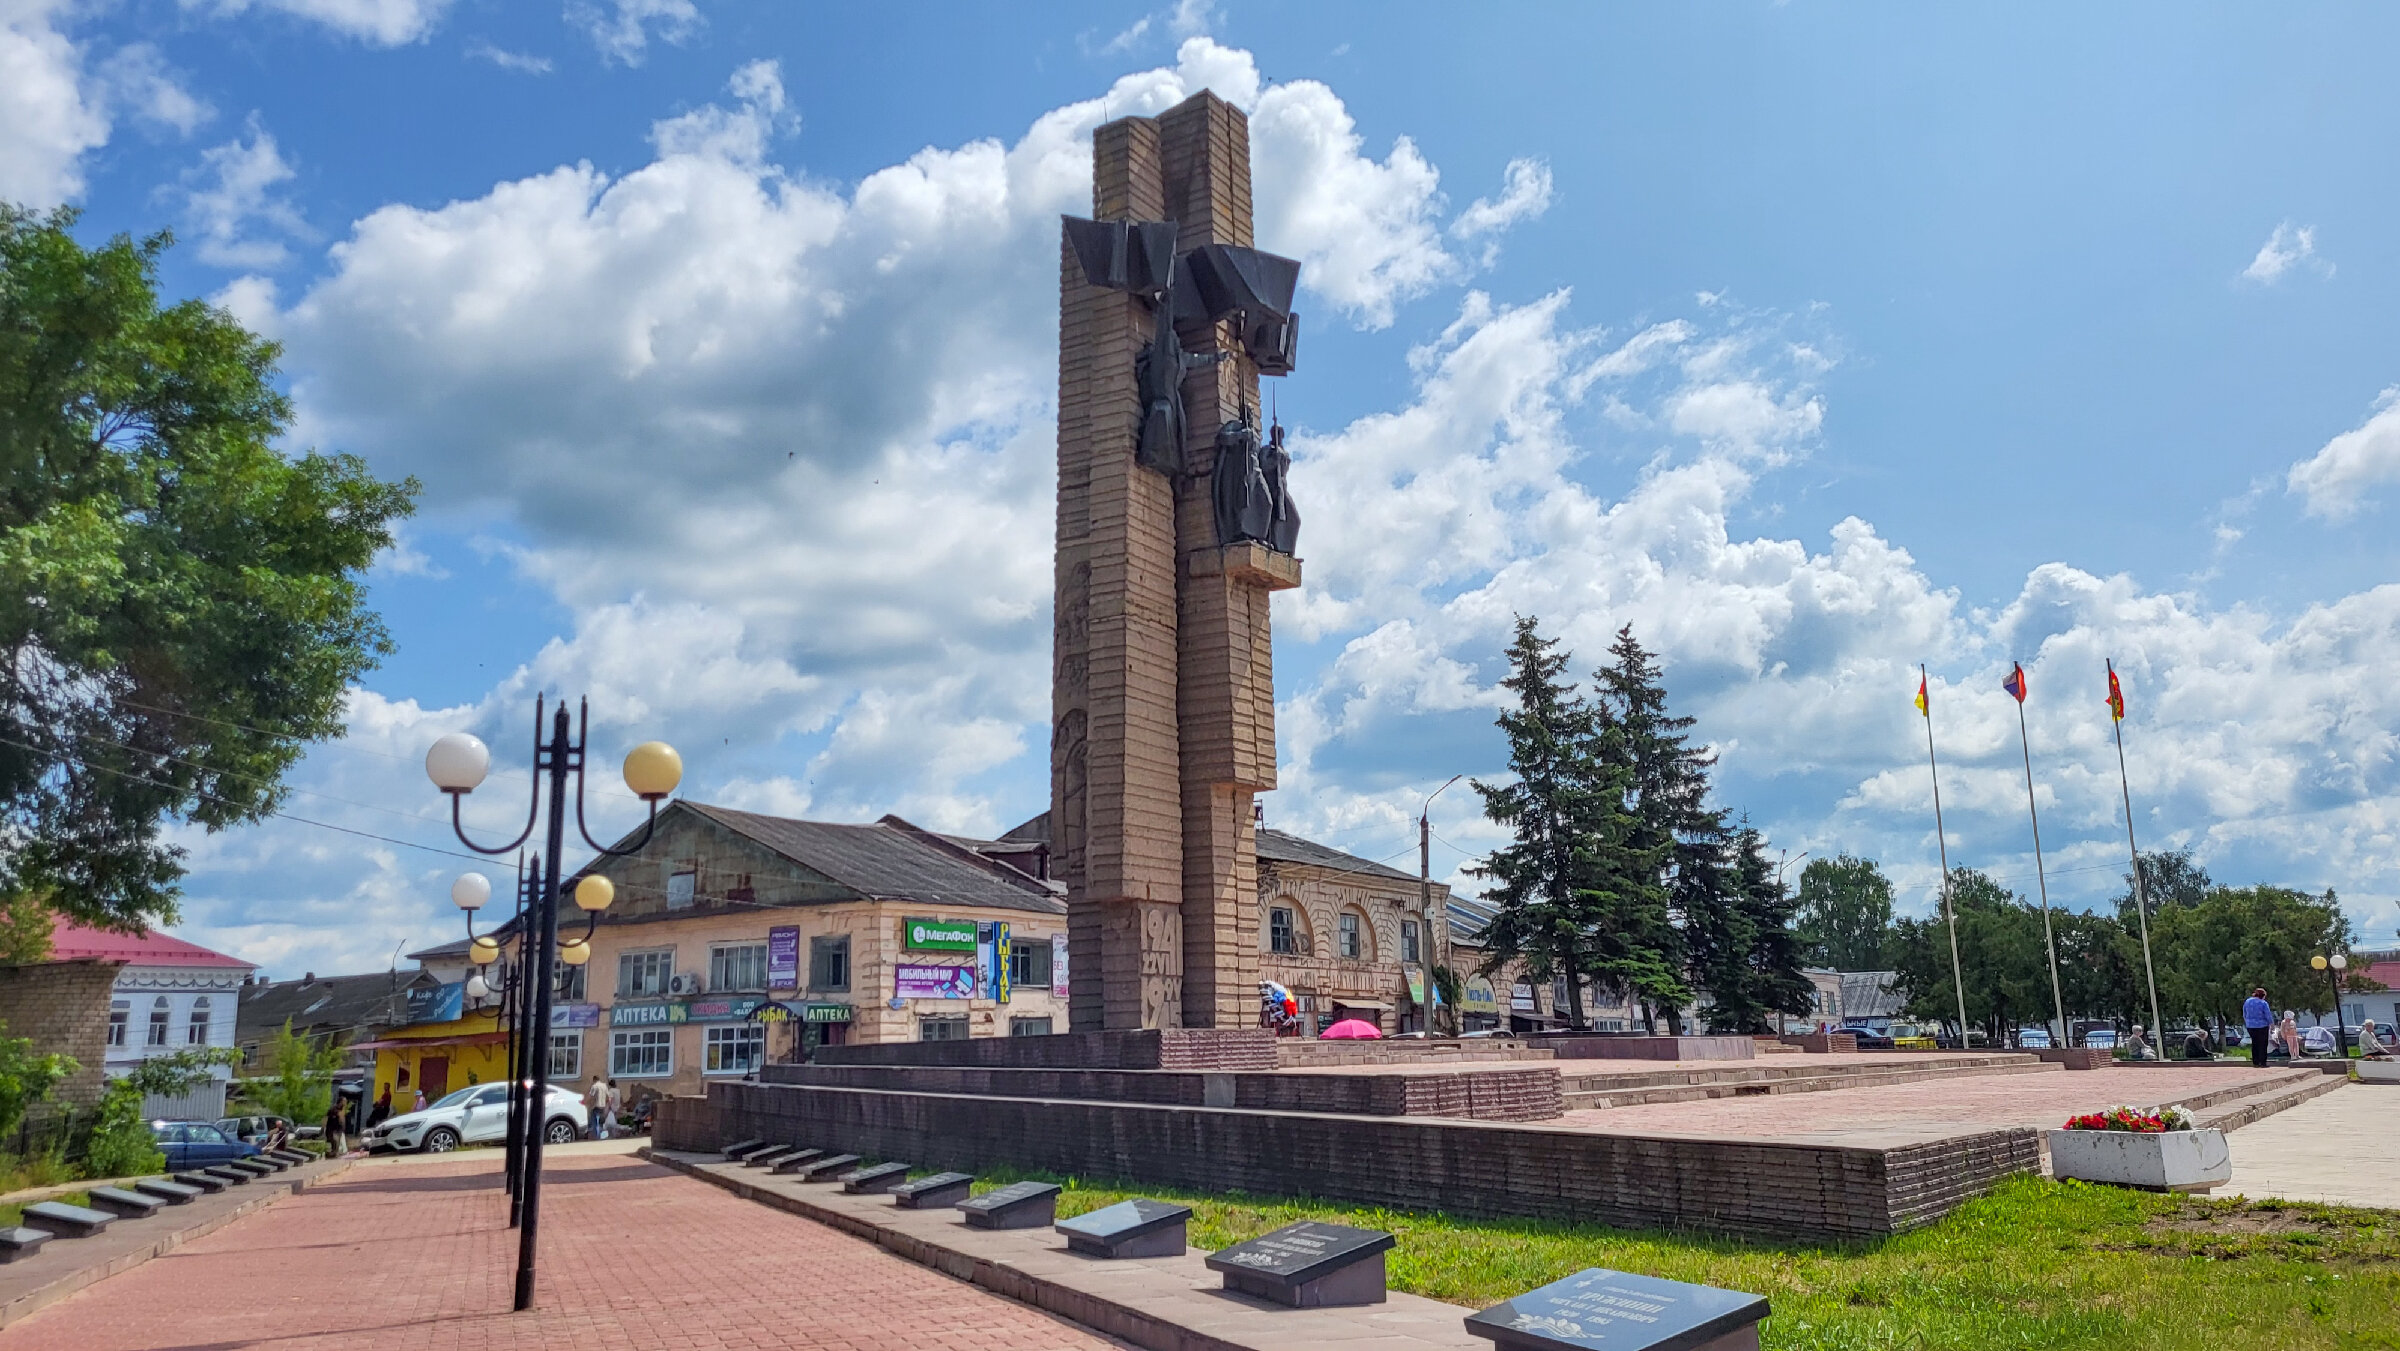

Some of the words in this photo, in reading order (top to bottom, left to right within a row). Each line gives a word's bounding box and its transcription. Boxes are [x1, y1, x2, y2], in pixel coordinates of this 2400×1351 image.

[998, 923, 1011, 1003] РЫБАК
[898, 966, 939, 980] МОБИЛЬНЫЙ
[939, 968, 953, 981] МИР
[614, 1006, 667, 1023] АПТЕКА
[757, 1006, 788, 1022] РЫБАК
[808, 1008, 851, 1021] АПТЕКА
